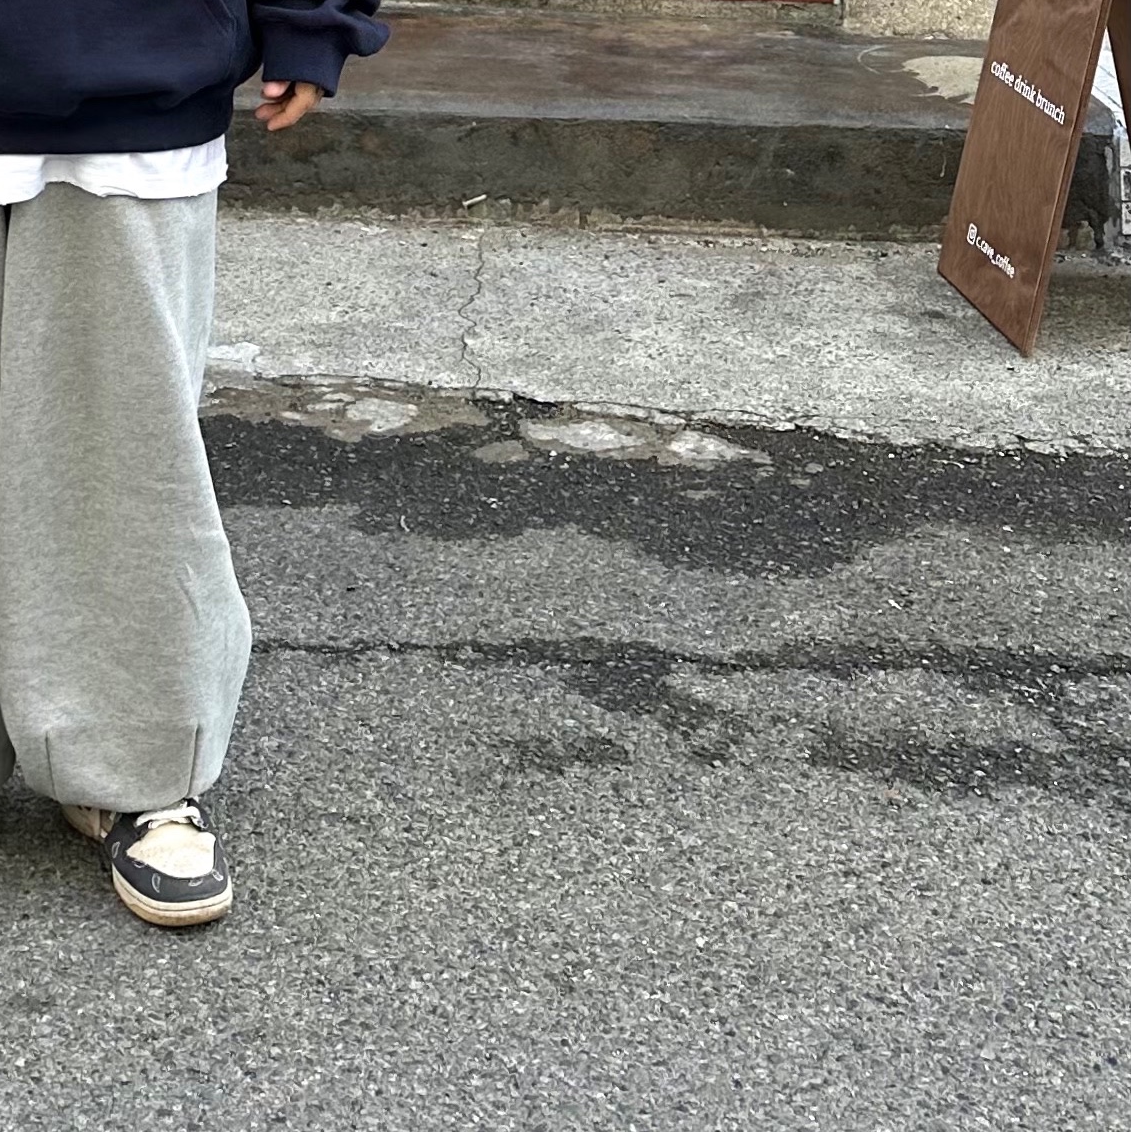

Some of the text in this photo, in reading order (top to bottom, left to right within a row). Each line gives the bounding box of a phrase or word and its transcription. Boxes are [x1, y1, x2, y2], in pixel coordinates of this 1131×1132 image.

[990, 61, 1065, 125] coffee drink brunch
